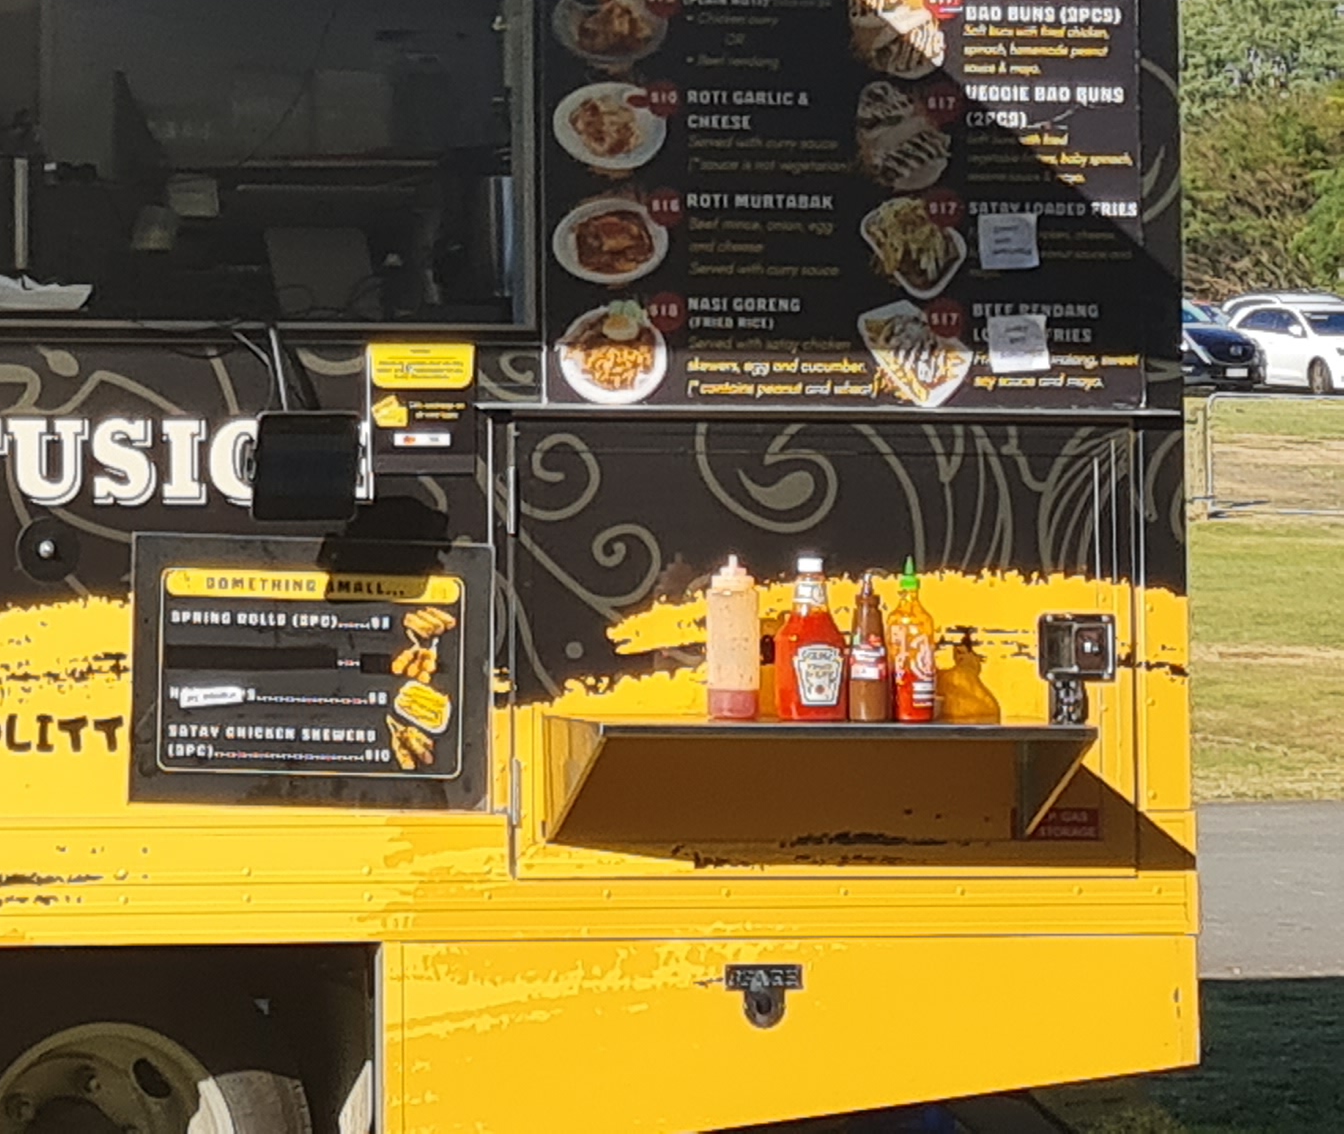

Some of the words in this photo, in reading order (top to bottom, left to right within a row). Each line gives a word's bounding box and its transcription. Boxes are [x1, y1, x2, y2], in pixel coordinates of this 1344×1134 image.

[1007, 6, 1055, 23] BUNS
[686, 89, 728, 105] ROTI
[732, 89, 792, 106] GARLIC
[797, 91, 810, 106] &
[964, 84, 1030, 102] VEGGIE
[1075, 86, 1126, 104] BUNS
[686, 113, 752, 130] CHEESE
[686, 192, 728, 208] ROTI
[733, 193, 834, 210] MURTABAK
[968, 201, 1021, 216] SATAY
[1089, 202, 1138, 217] FRIES
[687, 297, 728, 313] NASI
[732, 297, 801, 313] GORENG
[972, 302, 1013, 317] BEEF
[205, 576, 318, 592] SOMETHING
[170, 610, 232, 625] SPRING
[236, 611, 287, 626] ROLLS
[168, 724, 220, 738] SATAY
[225, 725, 296, 740] CHICKEN
[301, 727, 377, 743] SKEWERS
